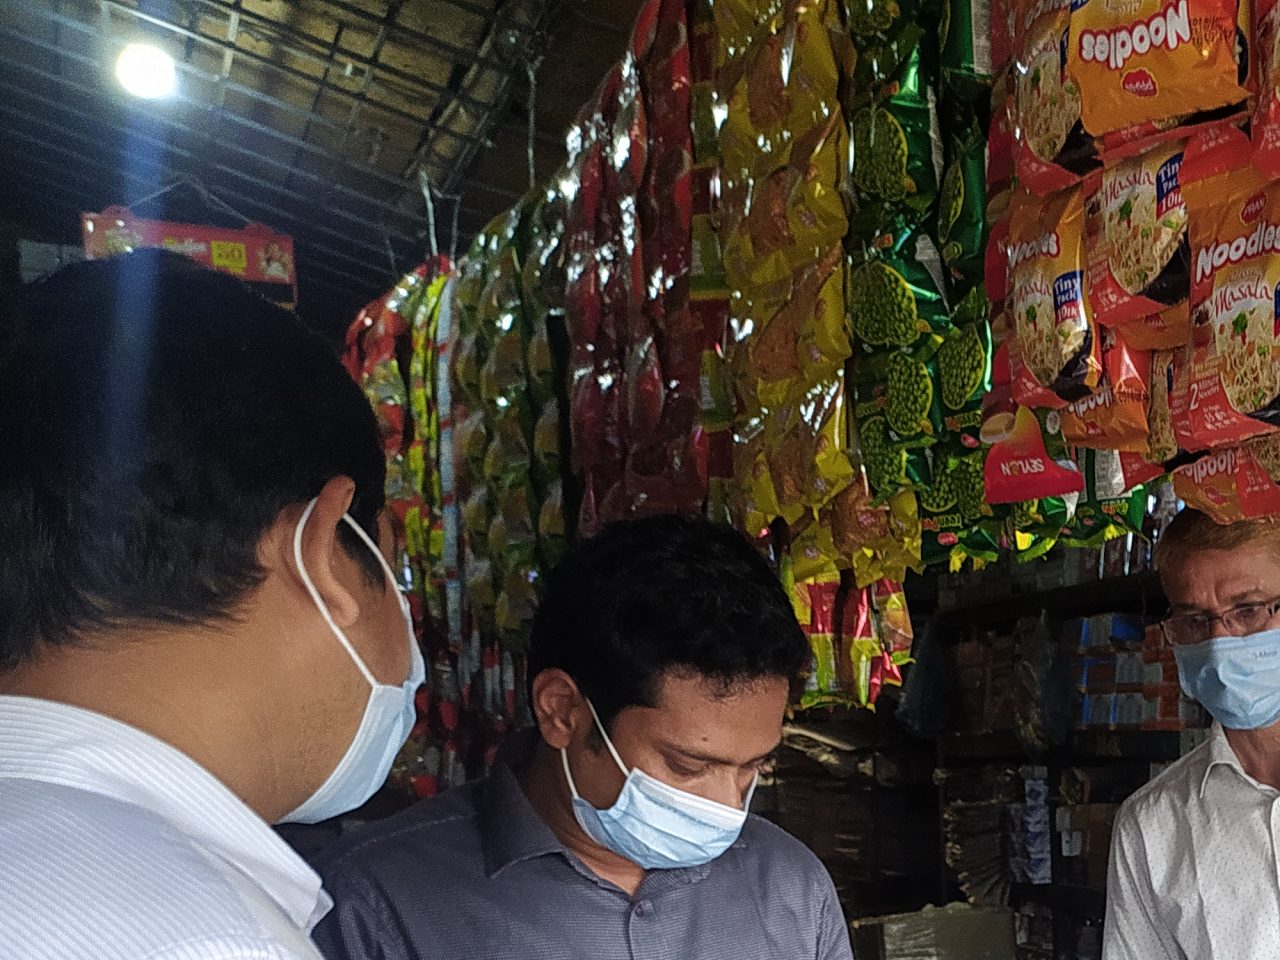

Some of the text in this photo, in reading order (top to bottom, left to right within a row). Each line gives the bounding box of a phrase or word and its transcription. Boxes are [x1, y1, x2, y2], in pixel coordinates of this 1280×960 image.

[1081, 0, 1191, 69] Noodles
[1163, 178, 1179, 195] Pac
[1055, 278, 1081, 295] Tiny
[1214, 275, 1273, 317] Masala
